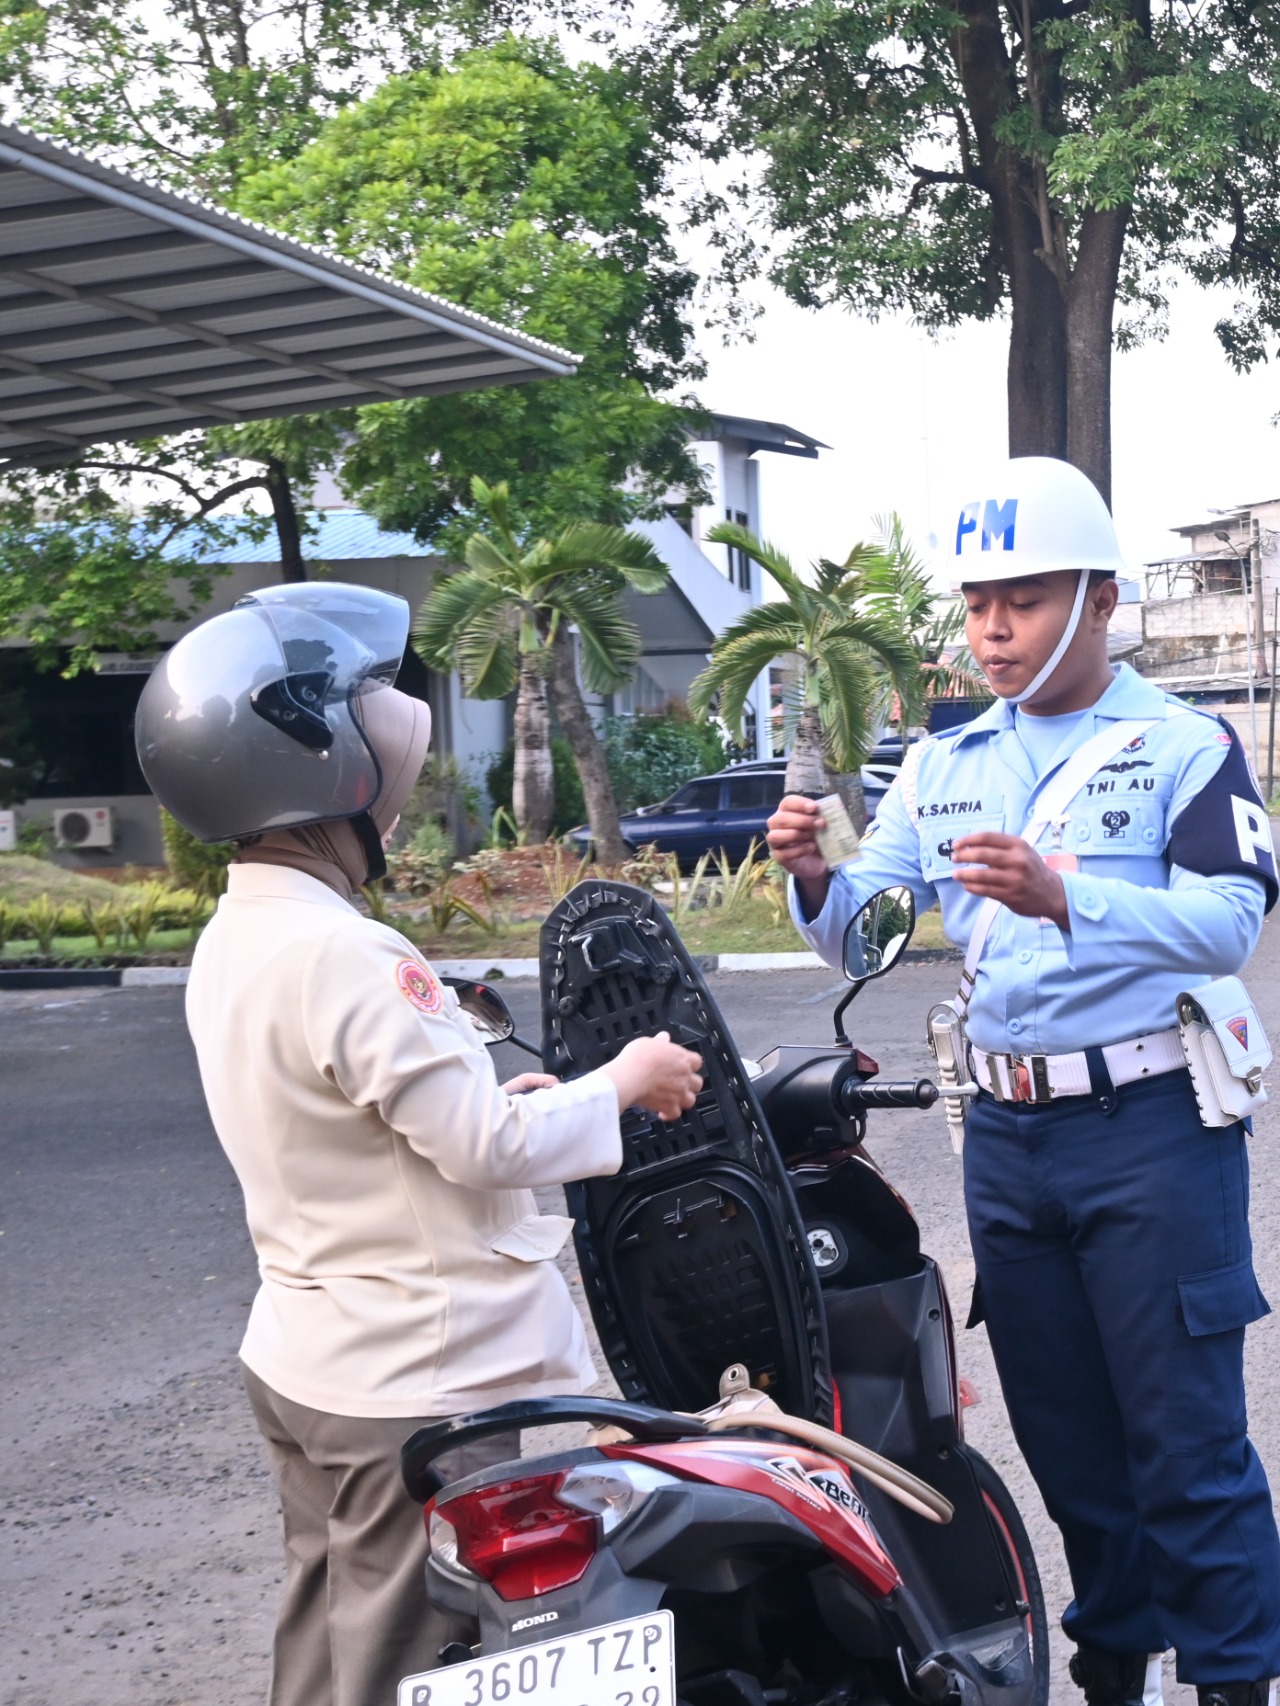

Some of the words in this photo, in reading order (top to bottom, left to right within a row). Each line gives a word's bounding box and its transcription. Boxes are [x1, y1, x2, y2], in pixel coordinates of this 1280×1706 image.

[955, 499, 1018, 556] PM
[1086, 781, 1115, 796] TNI
[1128, 778, 1155, 792] AU
[917, 800, 982, 819] K.SATRIA
[464, 1647, 566, 1706] 3607
[587, 1624, 662, 1676] TZP
